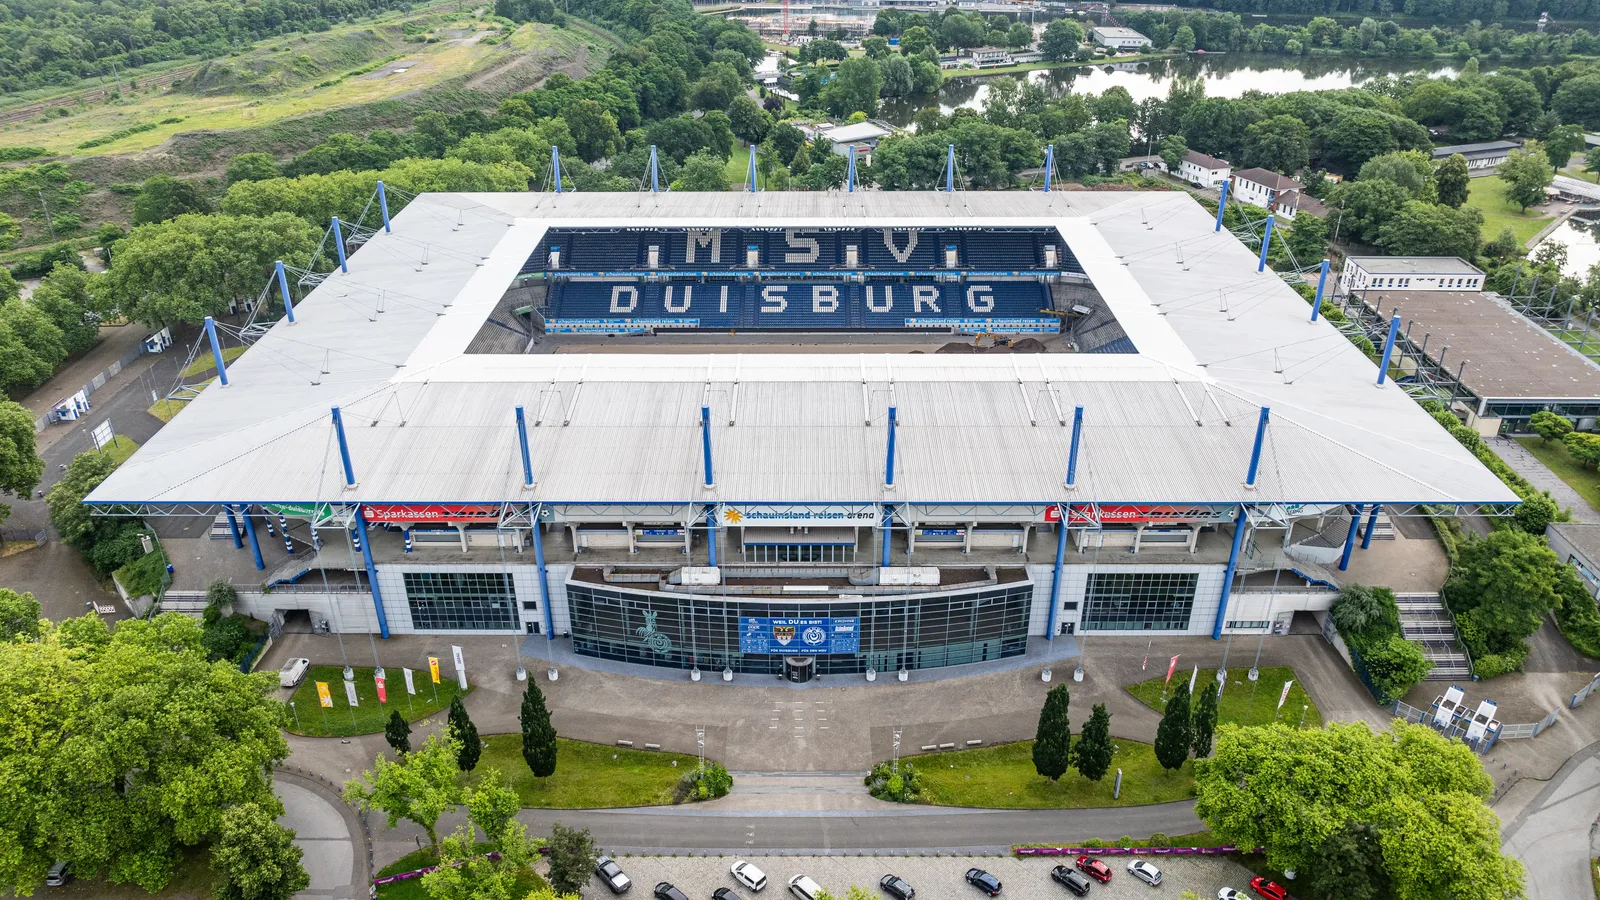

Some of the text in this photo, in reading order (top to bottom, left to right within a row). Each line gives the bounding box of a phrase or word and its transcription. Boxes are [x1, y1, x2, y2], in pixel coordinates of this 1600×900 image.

[686, 228, 918, 263] MSV
[610, 286, 994, 312] DUISBURG
[377, 510, 438, 519] Sparkassen
[746, 511, 810, 519] schauinsland
[814, 511, 844, 519] reisen
[1071, 510, 1136, 519] Sparkassen
